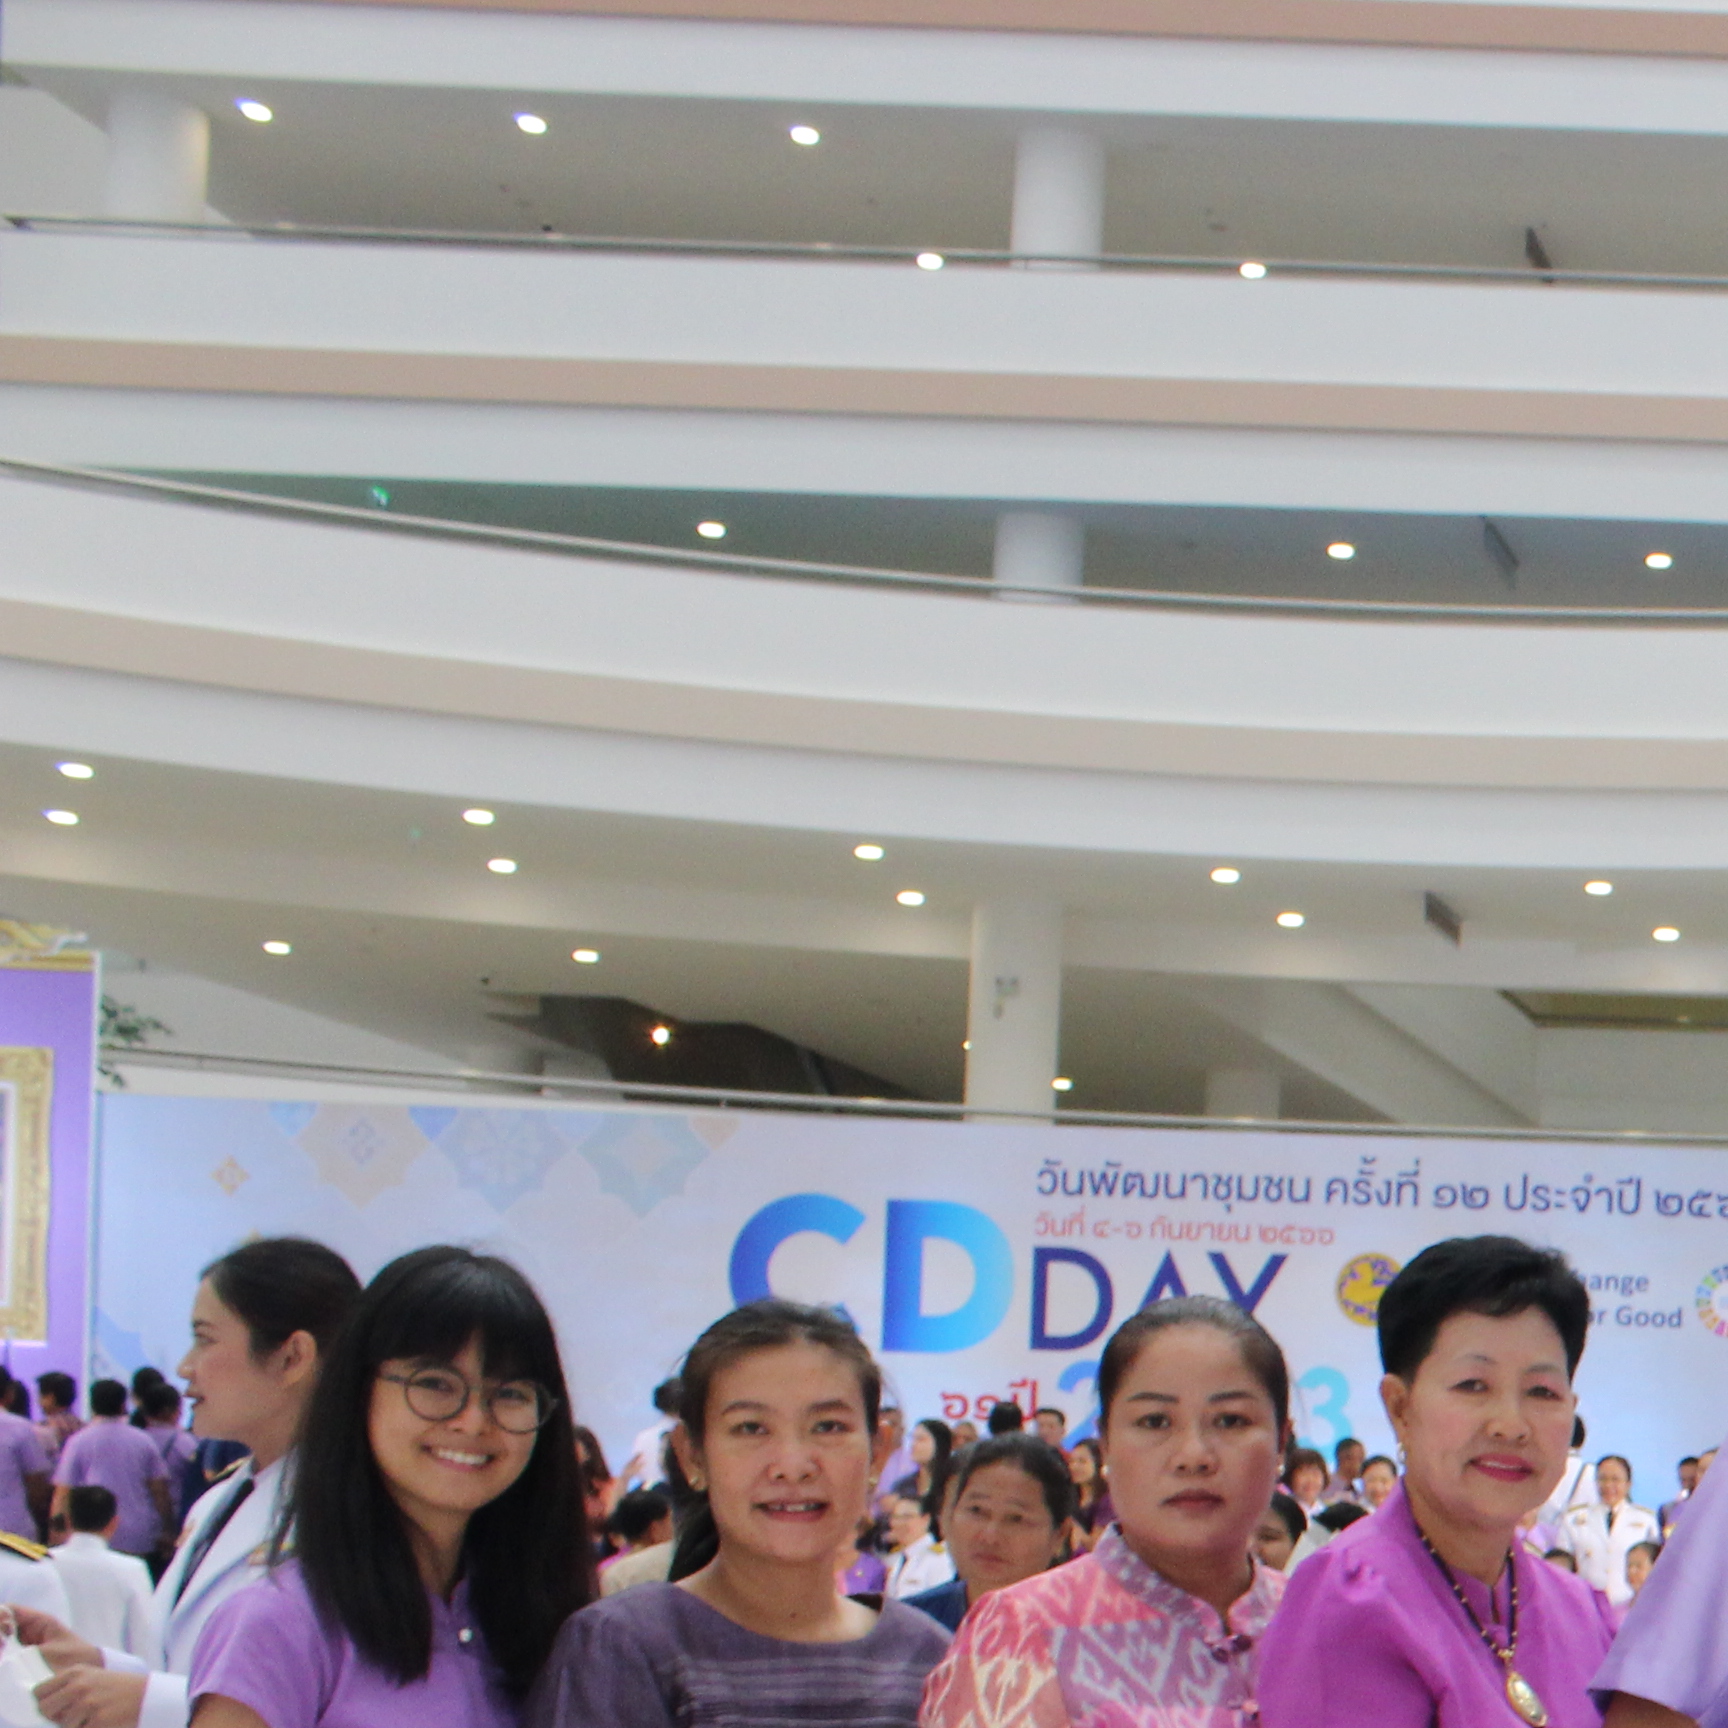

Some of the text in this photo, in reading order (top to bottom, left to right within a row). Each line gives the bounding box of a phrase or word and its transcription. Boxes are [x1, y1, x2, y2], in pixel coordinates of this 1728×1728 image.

[1036, 1157, 1312, 1214] วันพัฒนาชุมชน
[1324, 1155, 1421, 1207] ครั้งที่
[1432, 1183, 1491, 1210] ๑๒
[1503, 1173, 1643, 1216] ประจำปี
[1615, 1305, 1682, 1328] Good
